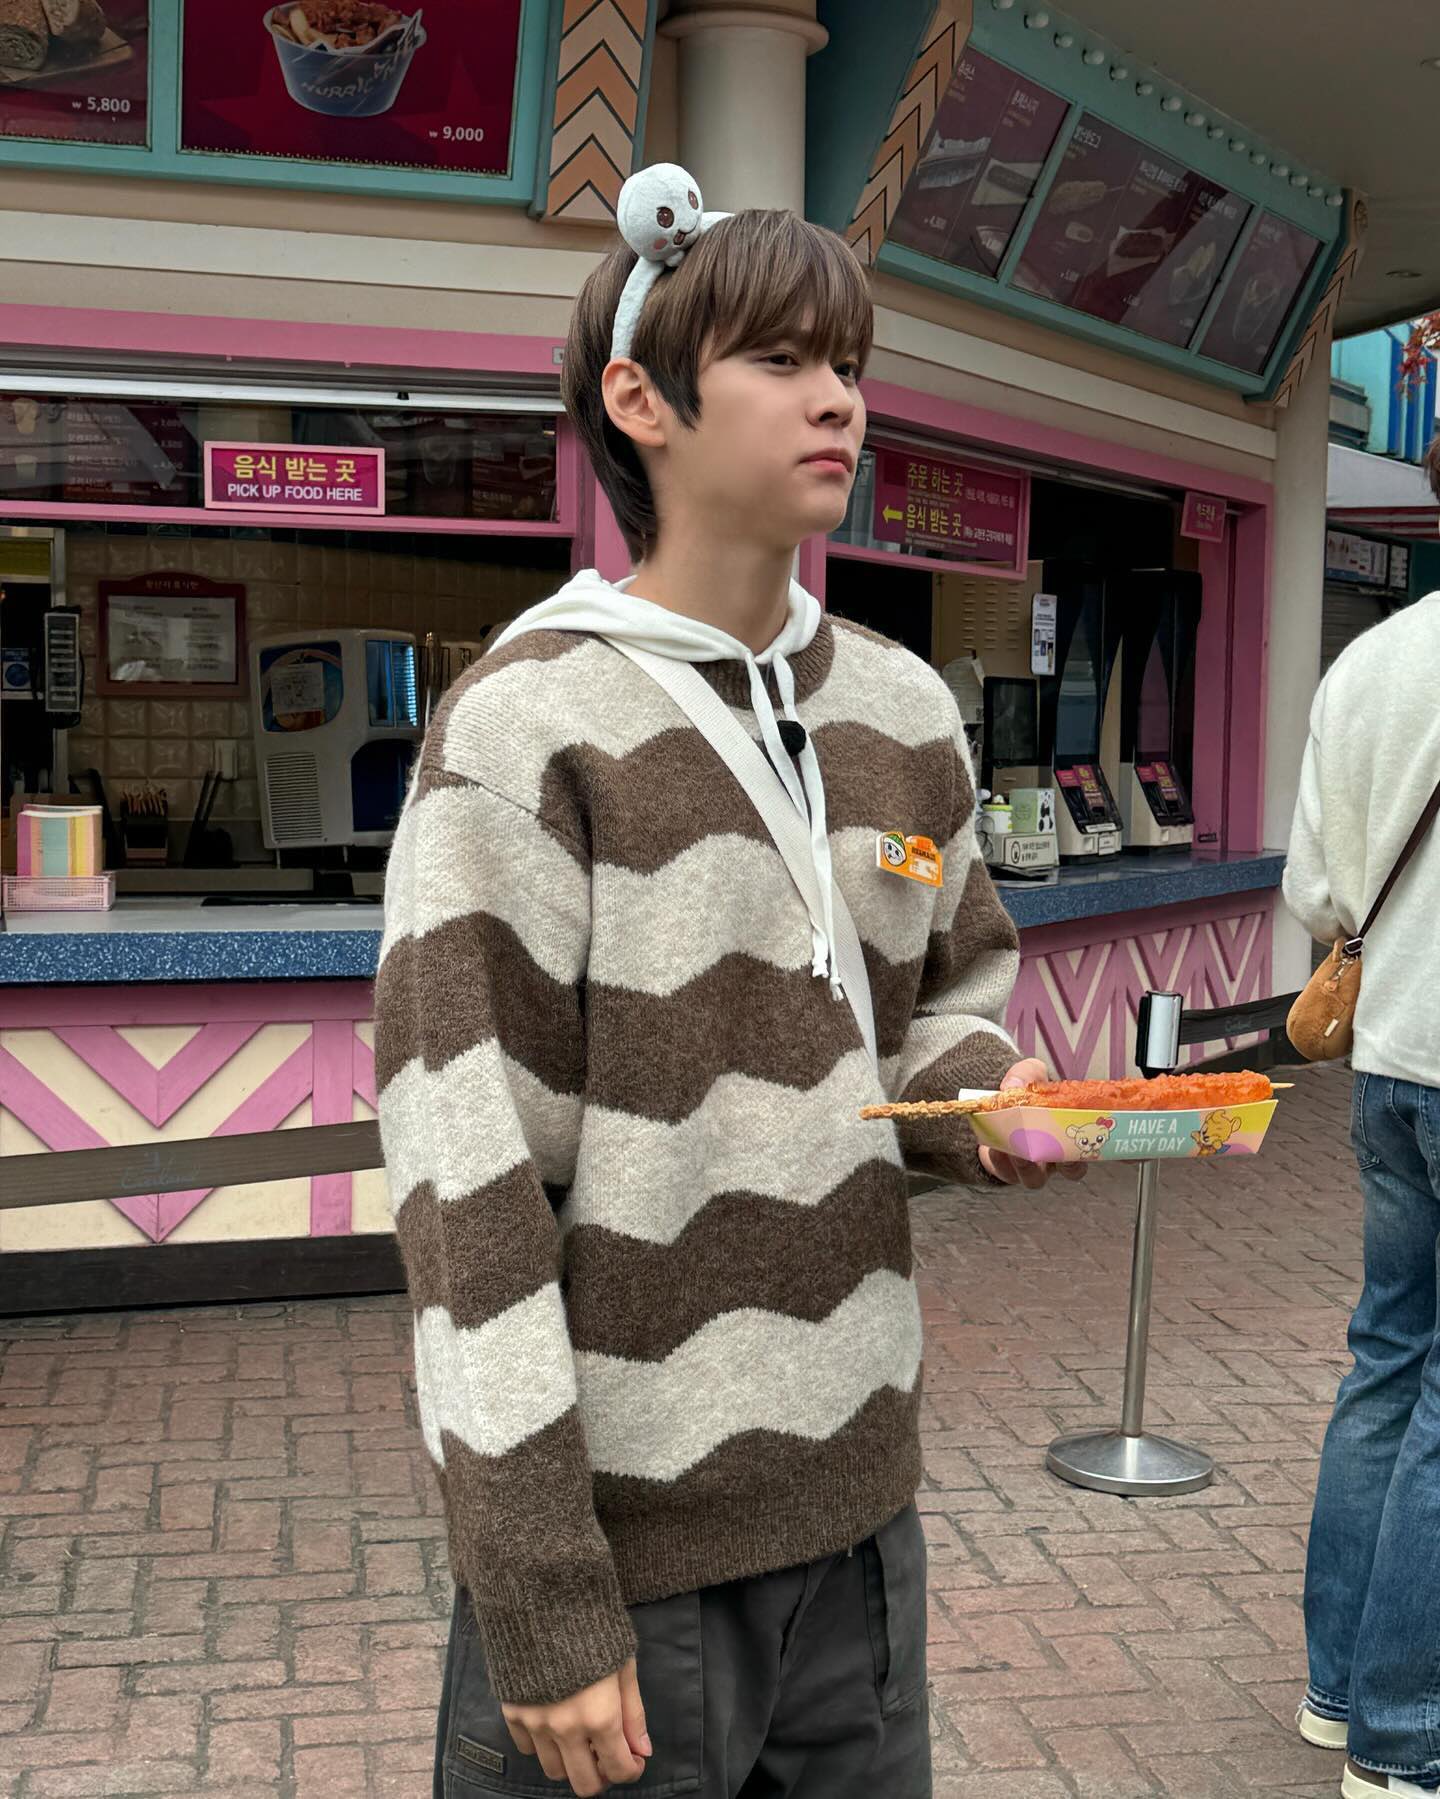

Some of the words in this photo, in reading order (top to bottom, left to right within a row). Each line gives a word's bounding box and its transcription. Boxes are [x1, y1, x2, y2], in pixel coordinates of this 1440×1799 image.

[87, 96, 131, 113] 5,800
[442, 125, 484, 142] 9,000
[234, 454, 277, 480] 음식
[285, 457, 328, 482] 받는
[335, 459, 356, 483] 곳
[907, 462, 928, 489] 주문
[931, 467, 950, 494] 하는
[954, 472, 964, 497] 곳
[227, 483, 259, 498] PICK
[262, 485, 281, 499] UP
[285, 486, 323, 500] FOOD
[327, 487, 363, 502] HERE
[906, 503, 926, 531] 음식
[930, 508, 949, 535] 받는
[952, 512, 962, 537] 곳
[1128, 1118, 1166, 1135] HAVE
[1168, 1118, 1177, 1134] A
[1114, 1138, 1156, 1153] TASTY
[1157, 1136, 1186, 1152] DAY
